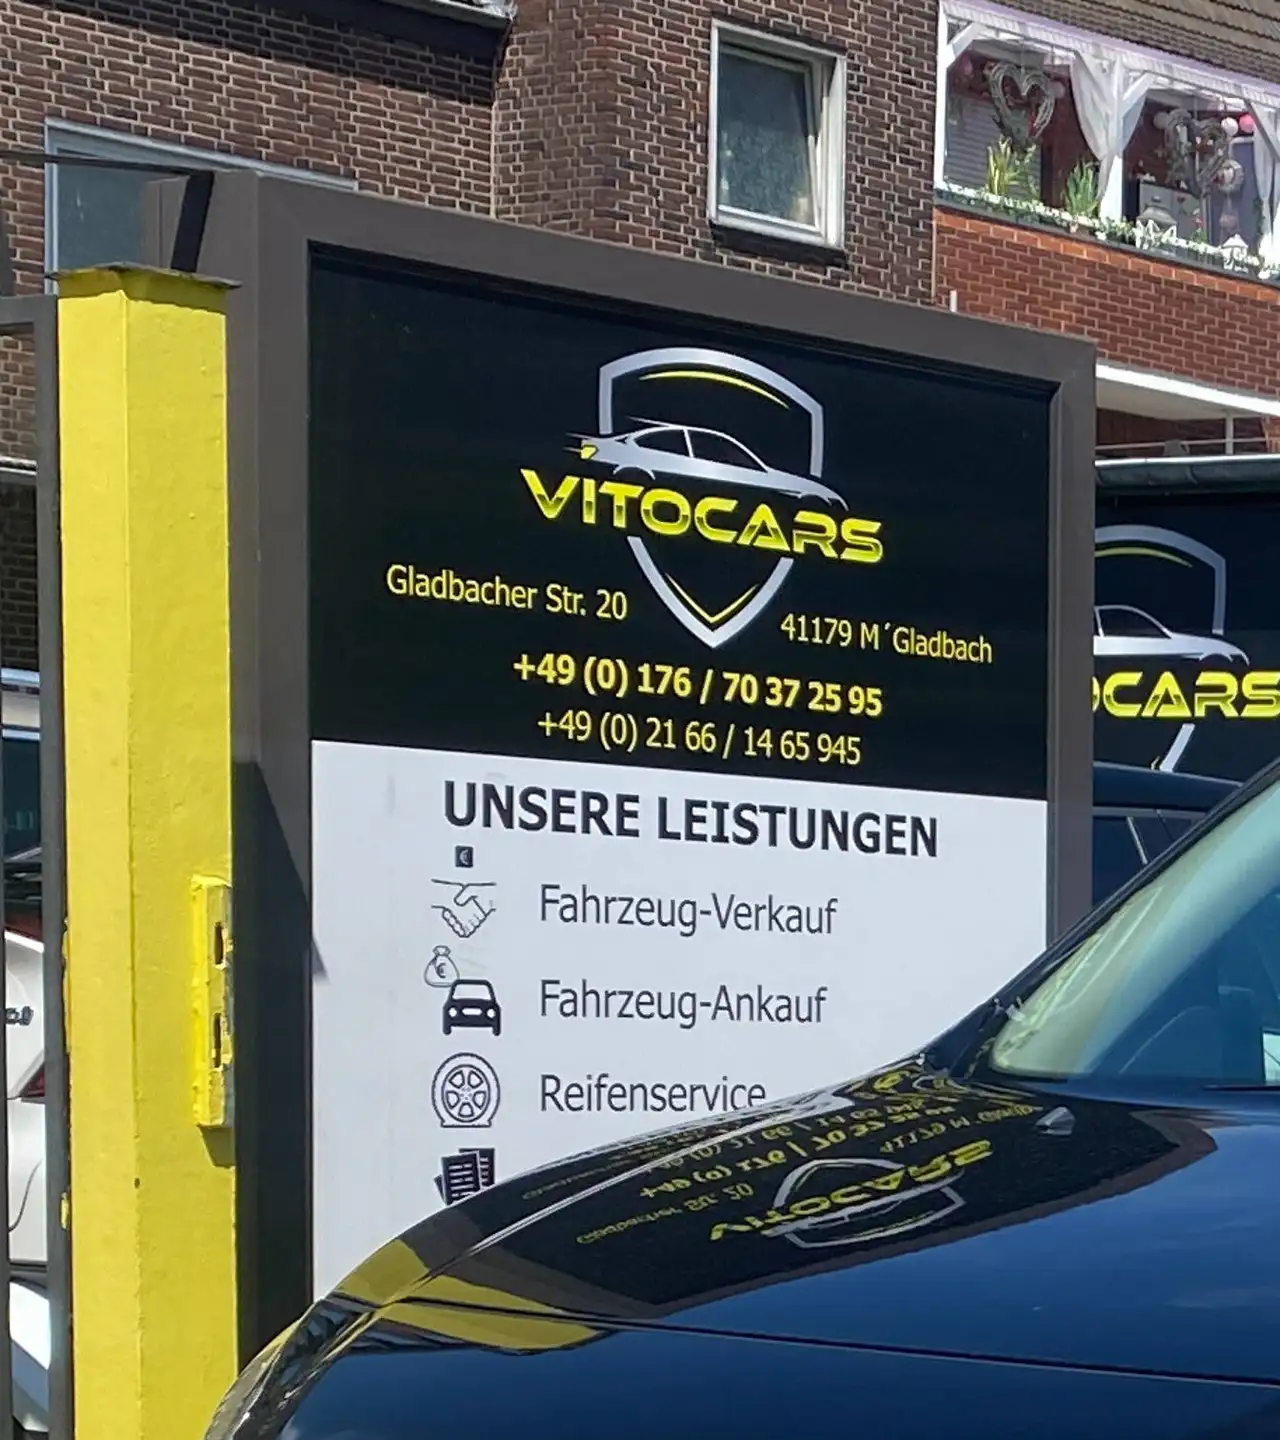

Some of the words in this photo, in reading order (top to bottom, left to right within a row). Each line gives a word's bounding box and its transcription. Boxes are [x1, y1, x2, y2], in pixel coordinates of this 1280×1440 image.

[521, 468, 883, 563] VITOCARS
[386, 564, 538, 610] Gladbacher
[546, 583, 587, 617] Str.
[596, 589, 628, 620] 20
[780, 613, 853, 648] 41179
[513, 653, 576, 686] +49
[584, 656, 629, 698] (0)
[637, 662, 692, 698] 176
[699, 669, 715, 705] /
[722, 673, 759, 705] 70
[765, 676, 800, 709] 37
[808, 681, 842, 713] 25
[848, 686, 884, 717] 95
[537, 710, 593, 743] +49
[600, 711, 639, 753] (0)
[646, 717, 677, 749] 21
[684, 721, 717, 752] 66
[721, 723, 736, 760] /
[744, 727, 773, 758] 14
[780, 730, 811, 761] 65
[817, 734, 862, 766] 945
[444, 779, 641, 839] UNSERE
[657, 796, 938, 858] LEISTUNGEN
[540, 883, 838, 938] Fahrzeug-Verkauf
[540, 978, 828, 1030] Fahrzeug-Ankauf
[540, 1072, 767, 1113] Reifenservice
